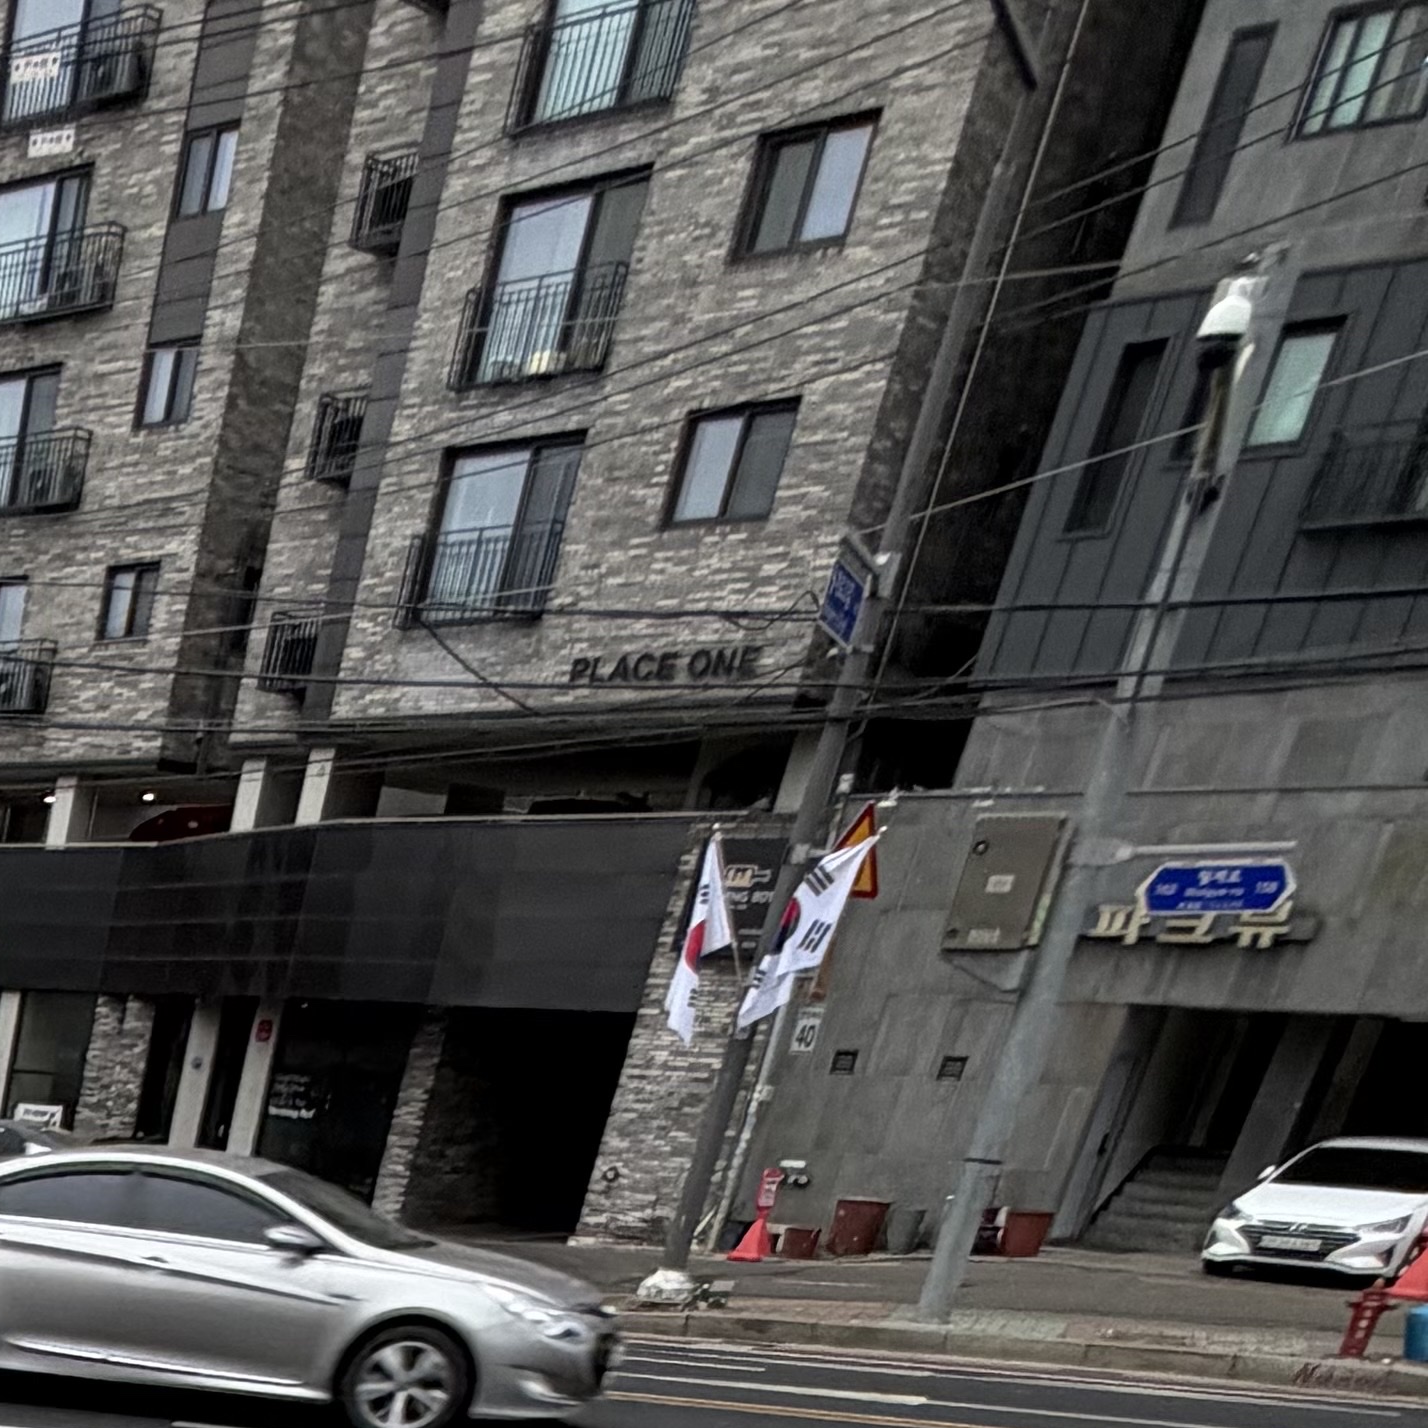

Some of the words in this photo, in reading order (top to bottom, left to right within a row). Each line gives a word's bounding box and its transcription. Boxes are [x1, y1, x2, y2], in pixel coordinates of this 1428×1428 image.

[569, 650, 680, 684] PLACE
[687, 645, 762, 679] ONE
[796, 1024, 816, 1048] 40
